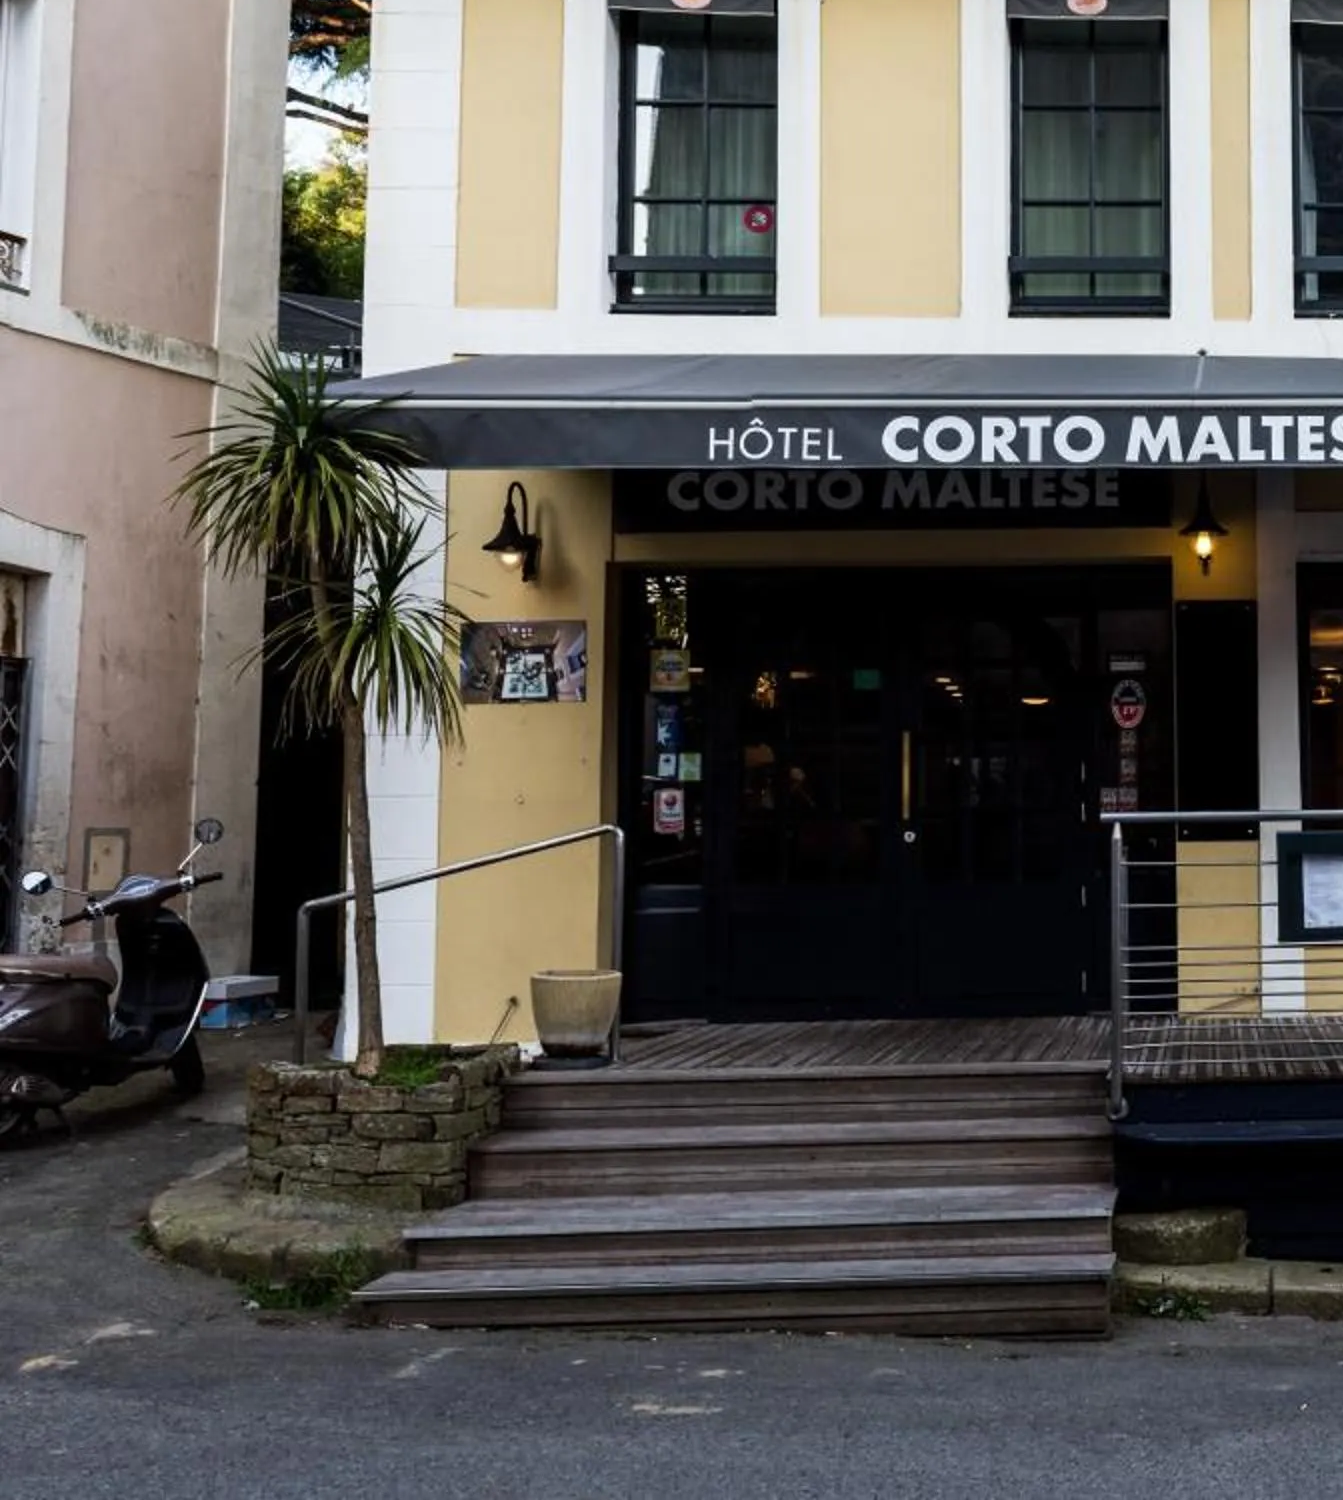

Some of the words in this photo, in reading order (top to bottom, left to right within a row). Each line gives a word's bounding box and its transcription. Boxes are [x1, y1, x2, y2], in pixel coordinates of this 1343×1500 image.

[708, 418, 843, 461] HÔTEL
[881, 415, 1104, 463] CORTO
[667, 469, 863, 511] CORTO
[881, 469, 1120, 509] MALTESE
